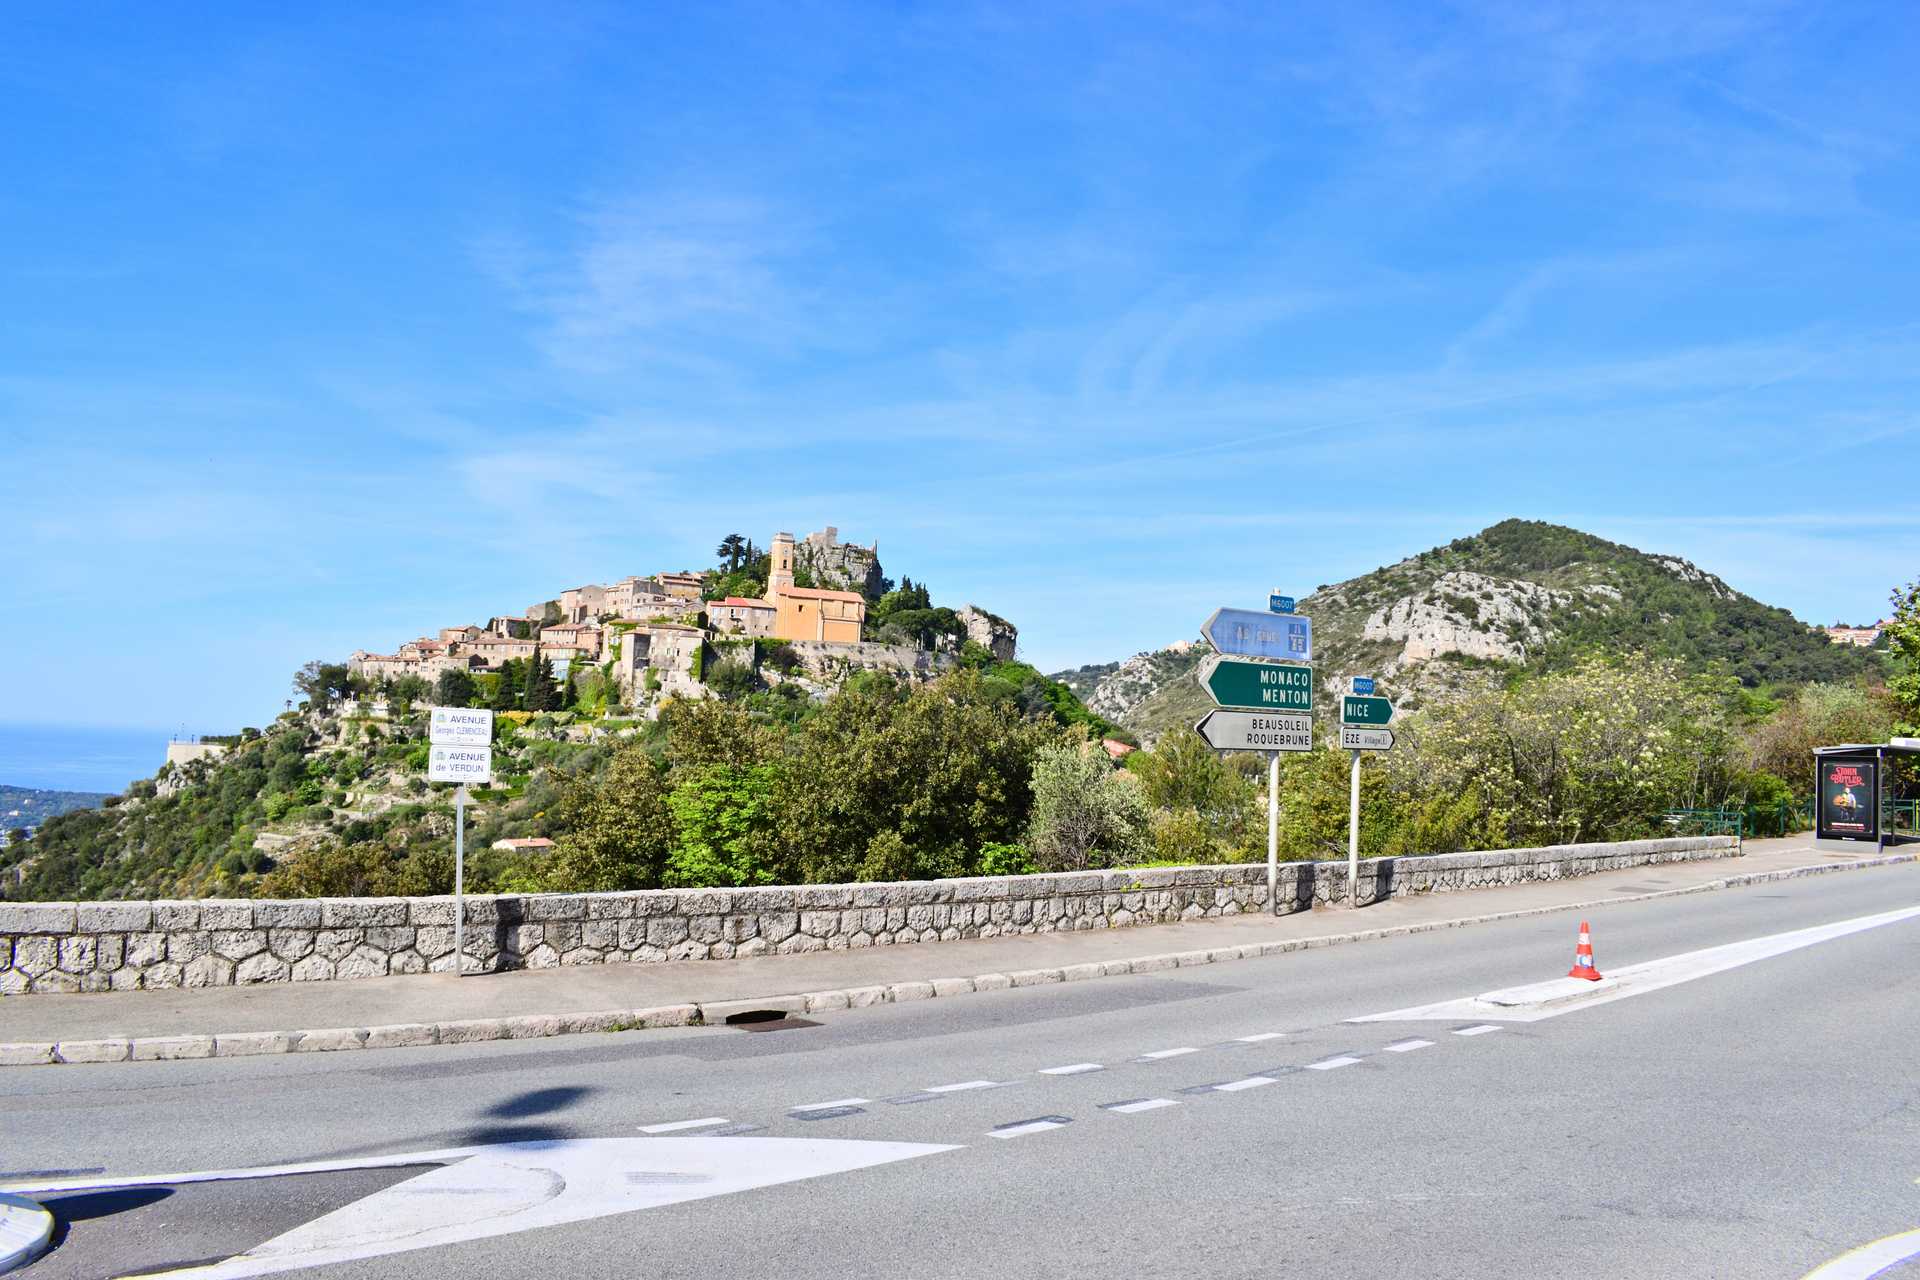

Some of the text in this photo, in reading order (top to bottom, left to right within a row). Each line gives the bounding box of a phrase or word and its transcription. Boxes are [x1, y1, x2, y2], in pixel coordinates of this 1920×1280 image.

[1271, 599, 1293, 609] M6007
[1260, 670, 1308, 686] MONACO
[1263, 689, 1308, 704] MENTON
[1346, 704, 1369, 717] NICE
[450, 715, 487, 724] AVENUE
[1252, 719, 1310, 732] BEAUSOLEIL
[1247, 733, 1310, 746] ROQUEBRUNE
[449, 752, 486, 762] AVENUE
[435, 763, 484, 772] de VERDUN
